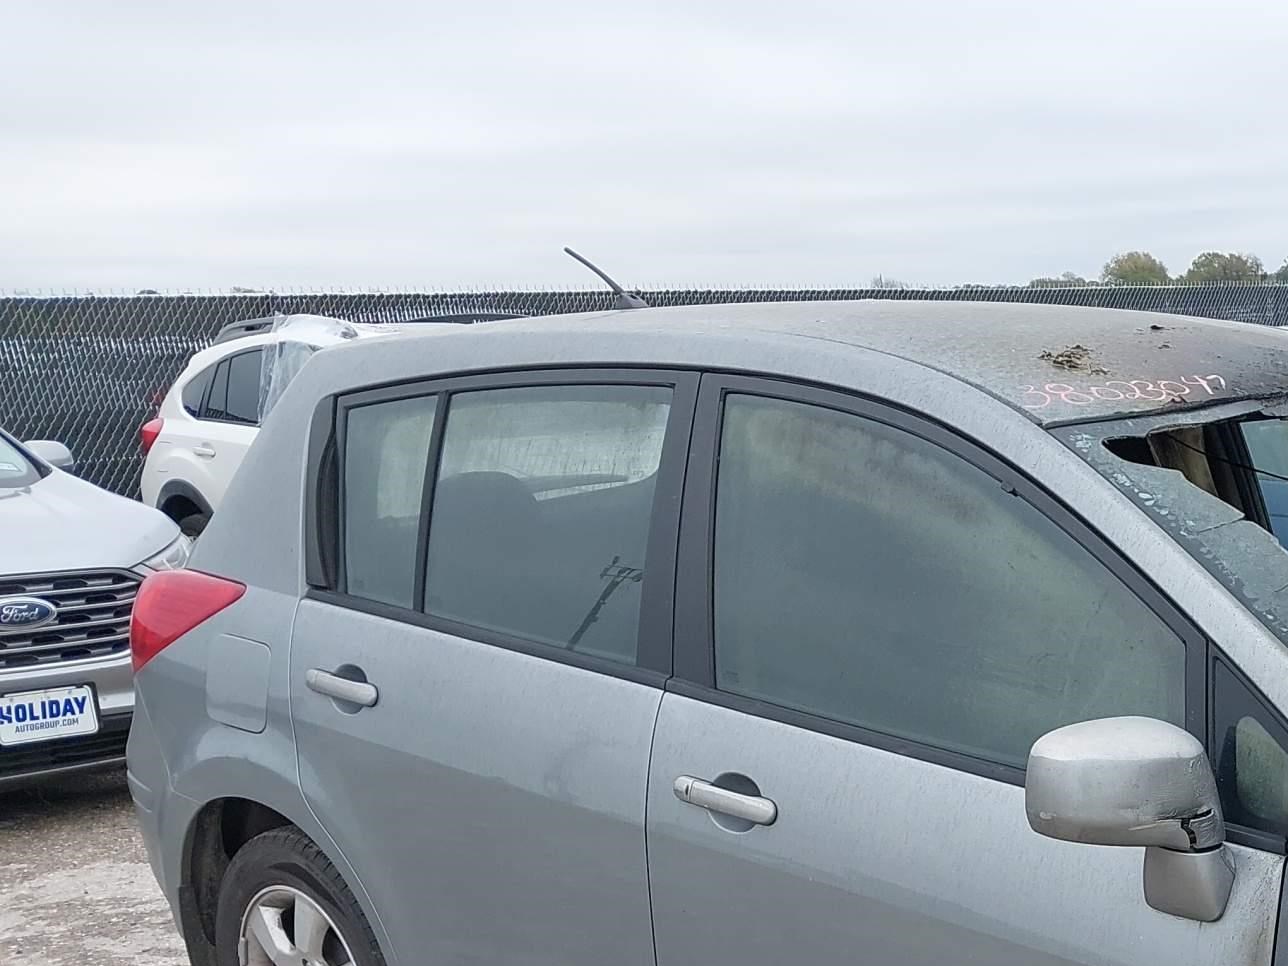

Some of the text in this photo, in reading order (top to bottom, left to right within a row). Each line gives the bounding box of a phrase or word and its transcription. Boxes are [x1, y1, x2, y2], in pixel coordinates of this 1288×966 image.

[1023, 374, 1227, 408] 38023047
[0, 603, 39, 622] Ford
[0, 695, 87, 725] HOLIDAY
[15, 717, 80, 733] AUTOGROUP.COM
